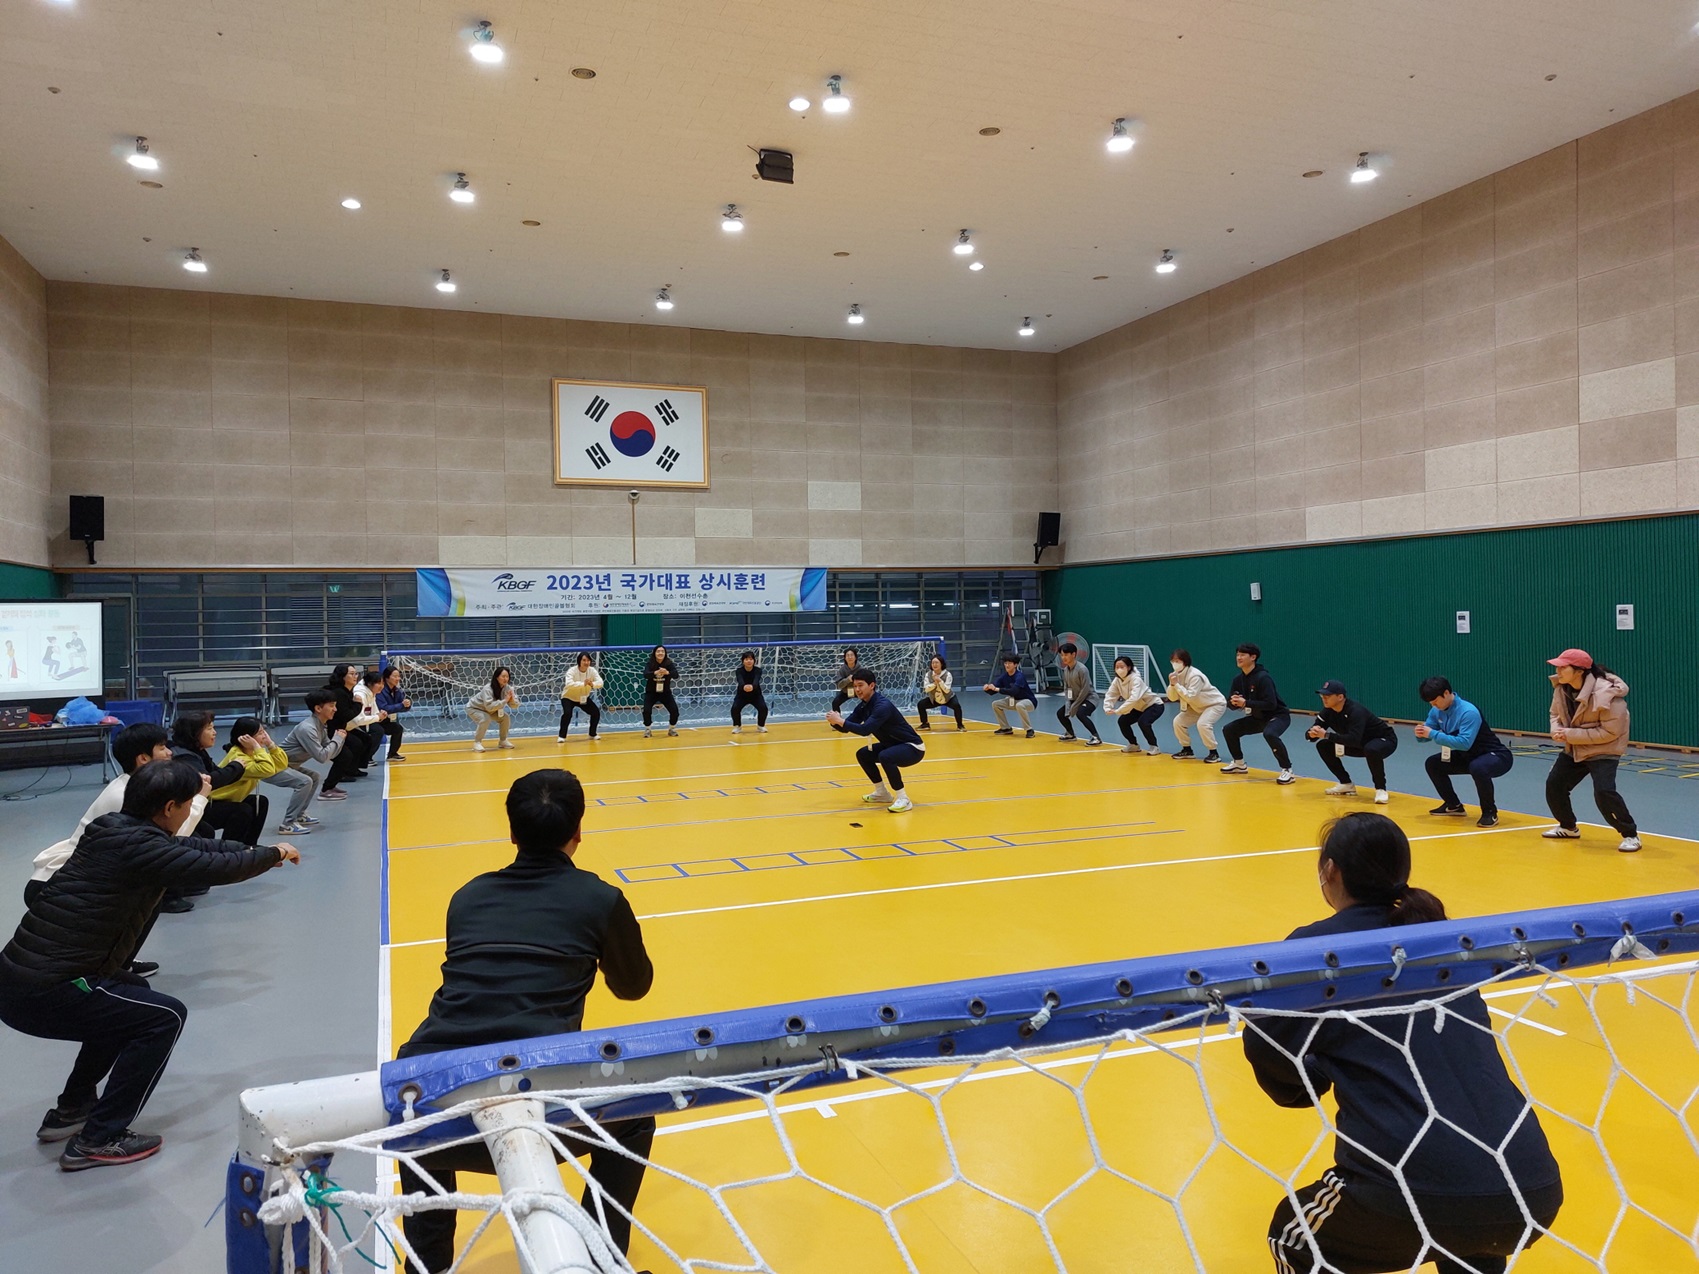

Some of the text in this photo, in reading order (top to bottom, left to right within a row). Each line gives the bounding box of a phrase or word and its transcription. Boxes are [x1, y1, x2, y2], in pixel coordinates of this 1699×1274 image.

[497, 580, 537, 590] KBGF
[546, 573, 766, 592] 2023년 국가대표 상시훈련
[624, 593, 637, 601] 12월
